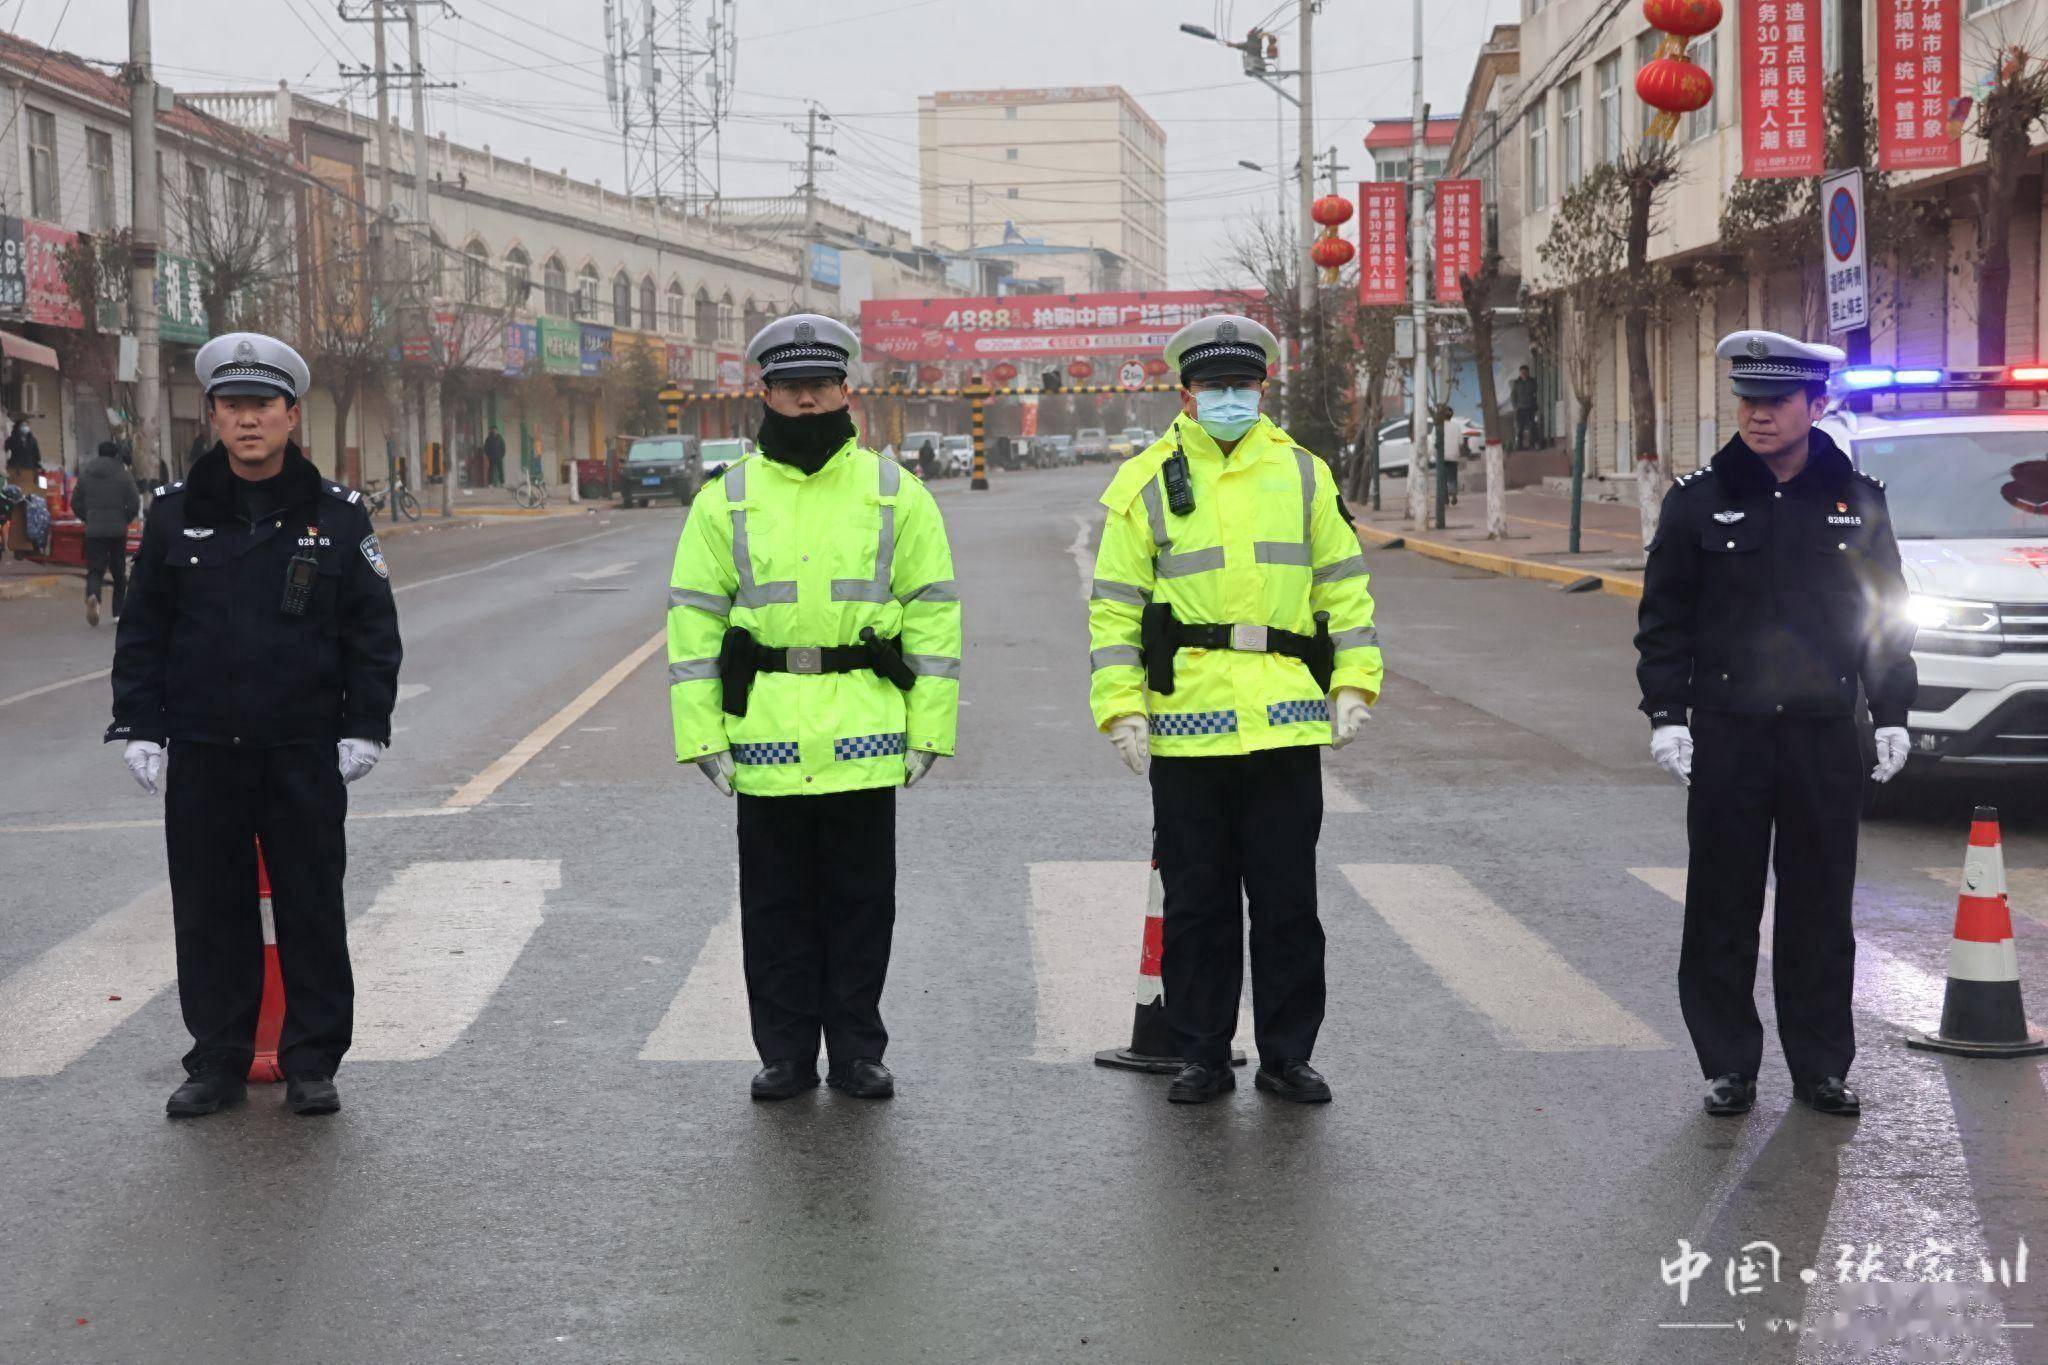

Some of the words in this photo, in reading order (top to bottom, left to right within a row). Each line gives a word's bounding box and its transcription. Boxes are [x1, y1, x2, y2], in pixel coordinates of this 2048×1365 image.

[1757, 0, 1780, 149] 务30万消费人潮
[1786, 3, 1806, 148] 造重点民生工程
[1895, 62, 1915, 140] 统一管理
[1830, 264, 1862, 294] 道路两侧
[943, 309, 1011, 333] 4888
[1832, 296, 1863, 322] 禁止停车
[1827, 515, 1861, 525] 028815
[298, 538, 331, 546] 02803
